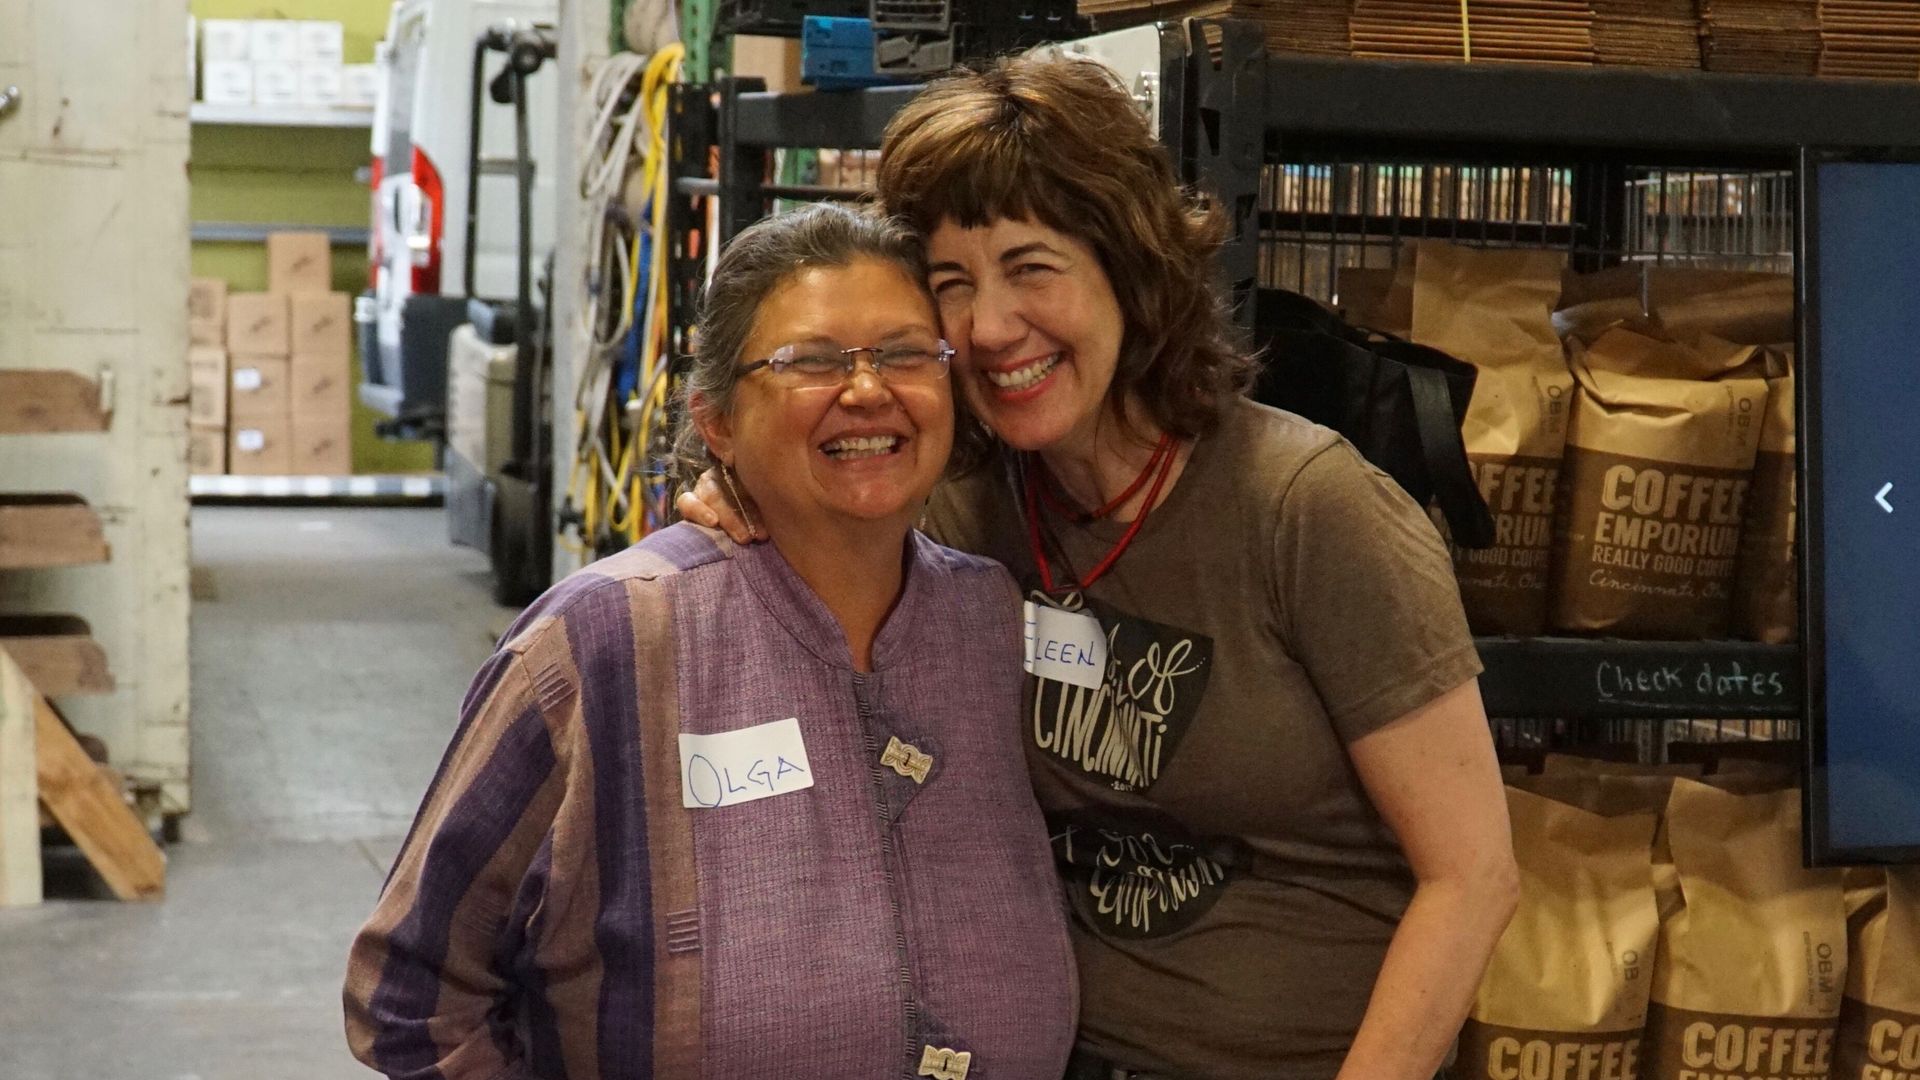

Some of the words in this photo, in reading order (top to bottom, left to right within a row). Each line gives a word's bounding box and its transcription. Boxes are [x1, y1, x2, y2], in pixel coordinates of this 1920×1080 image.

[1469, 460, 1560, 513] FFEE
[1602, 464, 1750, 524] COFFEE
[1595, 512, 1739, 556] EMPORIUM
[1592, 544, 1650, 571] REALLY
[1653, 555, 1694, 575] GOOD
[1597, 660, 1683, 698] Check
[1696, 660, 1784, 696] dates
[688, 753, 804, 809] OLGA
[1623, 949, 1639, 981] OB
[1816, 942, 1833, 993] OBM
[1488, 1036, 1640, 1080] COFFEE
[1682, 1021, 1835, 1074] COFFEE
